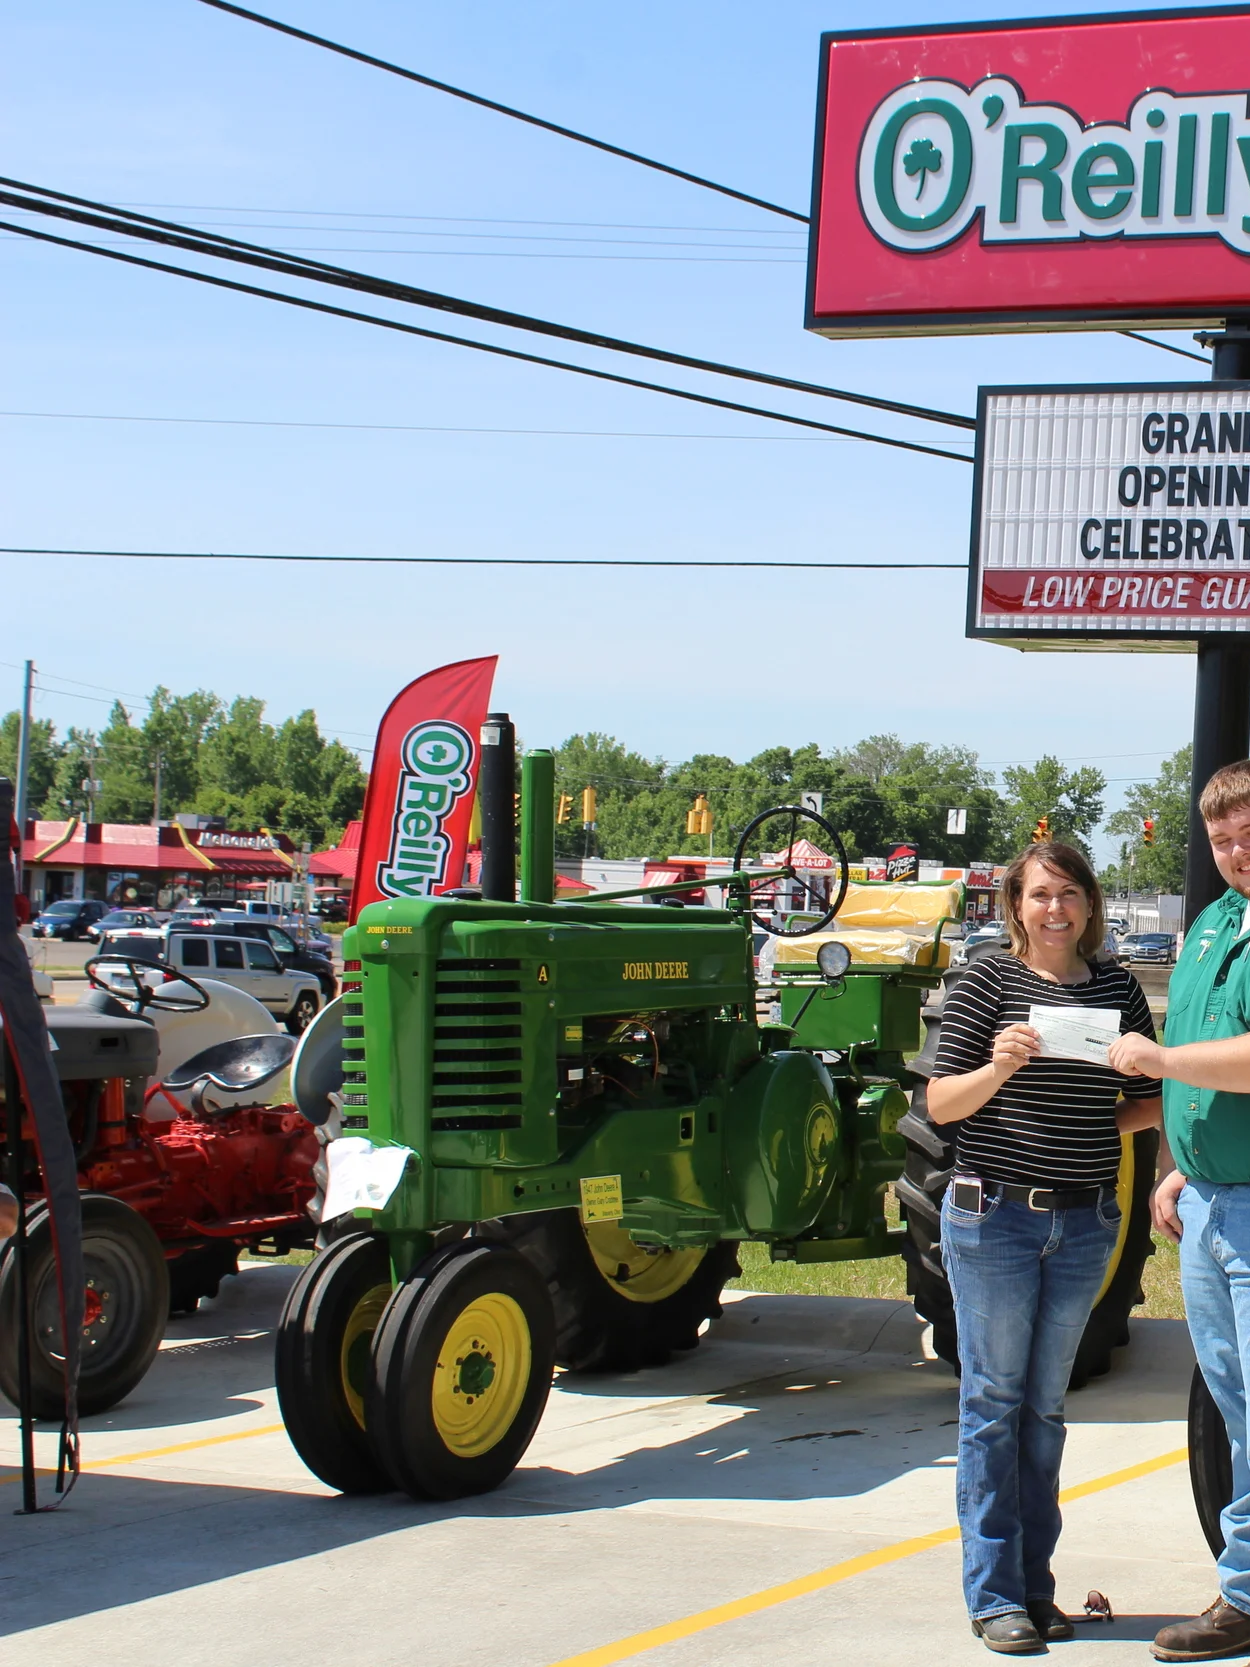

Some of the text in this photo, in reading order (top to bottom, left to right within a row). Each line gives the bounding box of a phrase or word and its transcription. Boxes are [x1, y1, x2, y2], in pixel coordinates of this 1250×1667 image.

[1022, 575, 1095, 608] LOW
[1098, 575, 1195, 610] PRICE
[790, 858, 828, 867] AVE-A-LOT
[887, 855, 917, 876] Pizza
[892, 865, 914, 878] Hut
[366, 926, 413, 934] JOHN DEERE
[538, 966, 548, 982] A
[622, 961, 689, 981] JOHN DEERE
